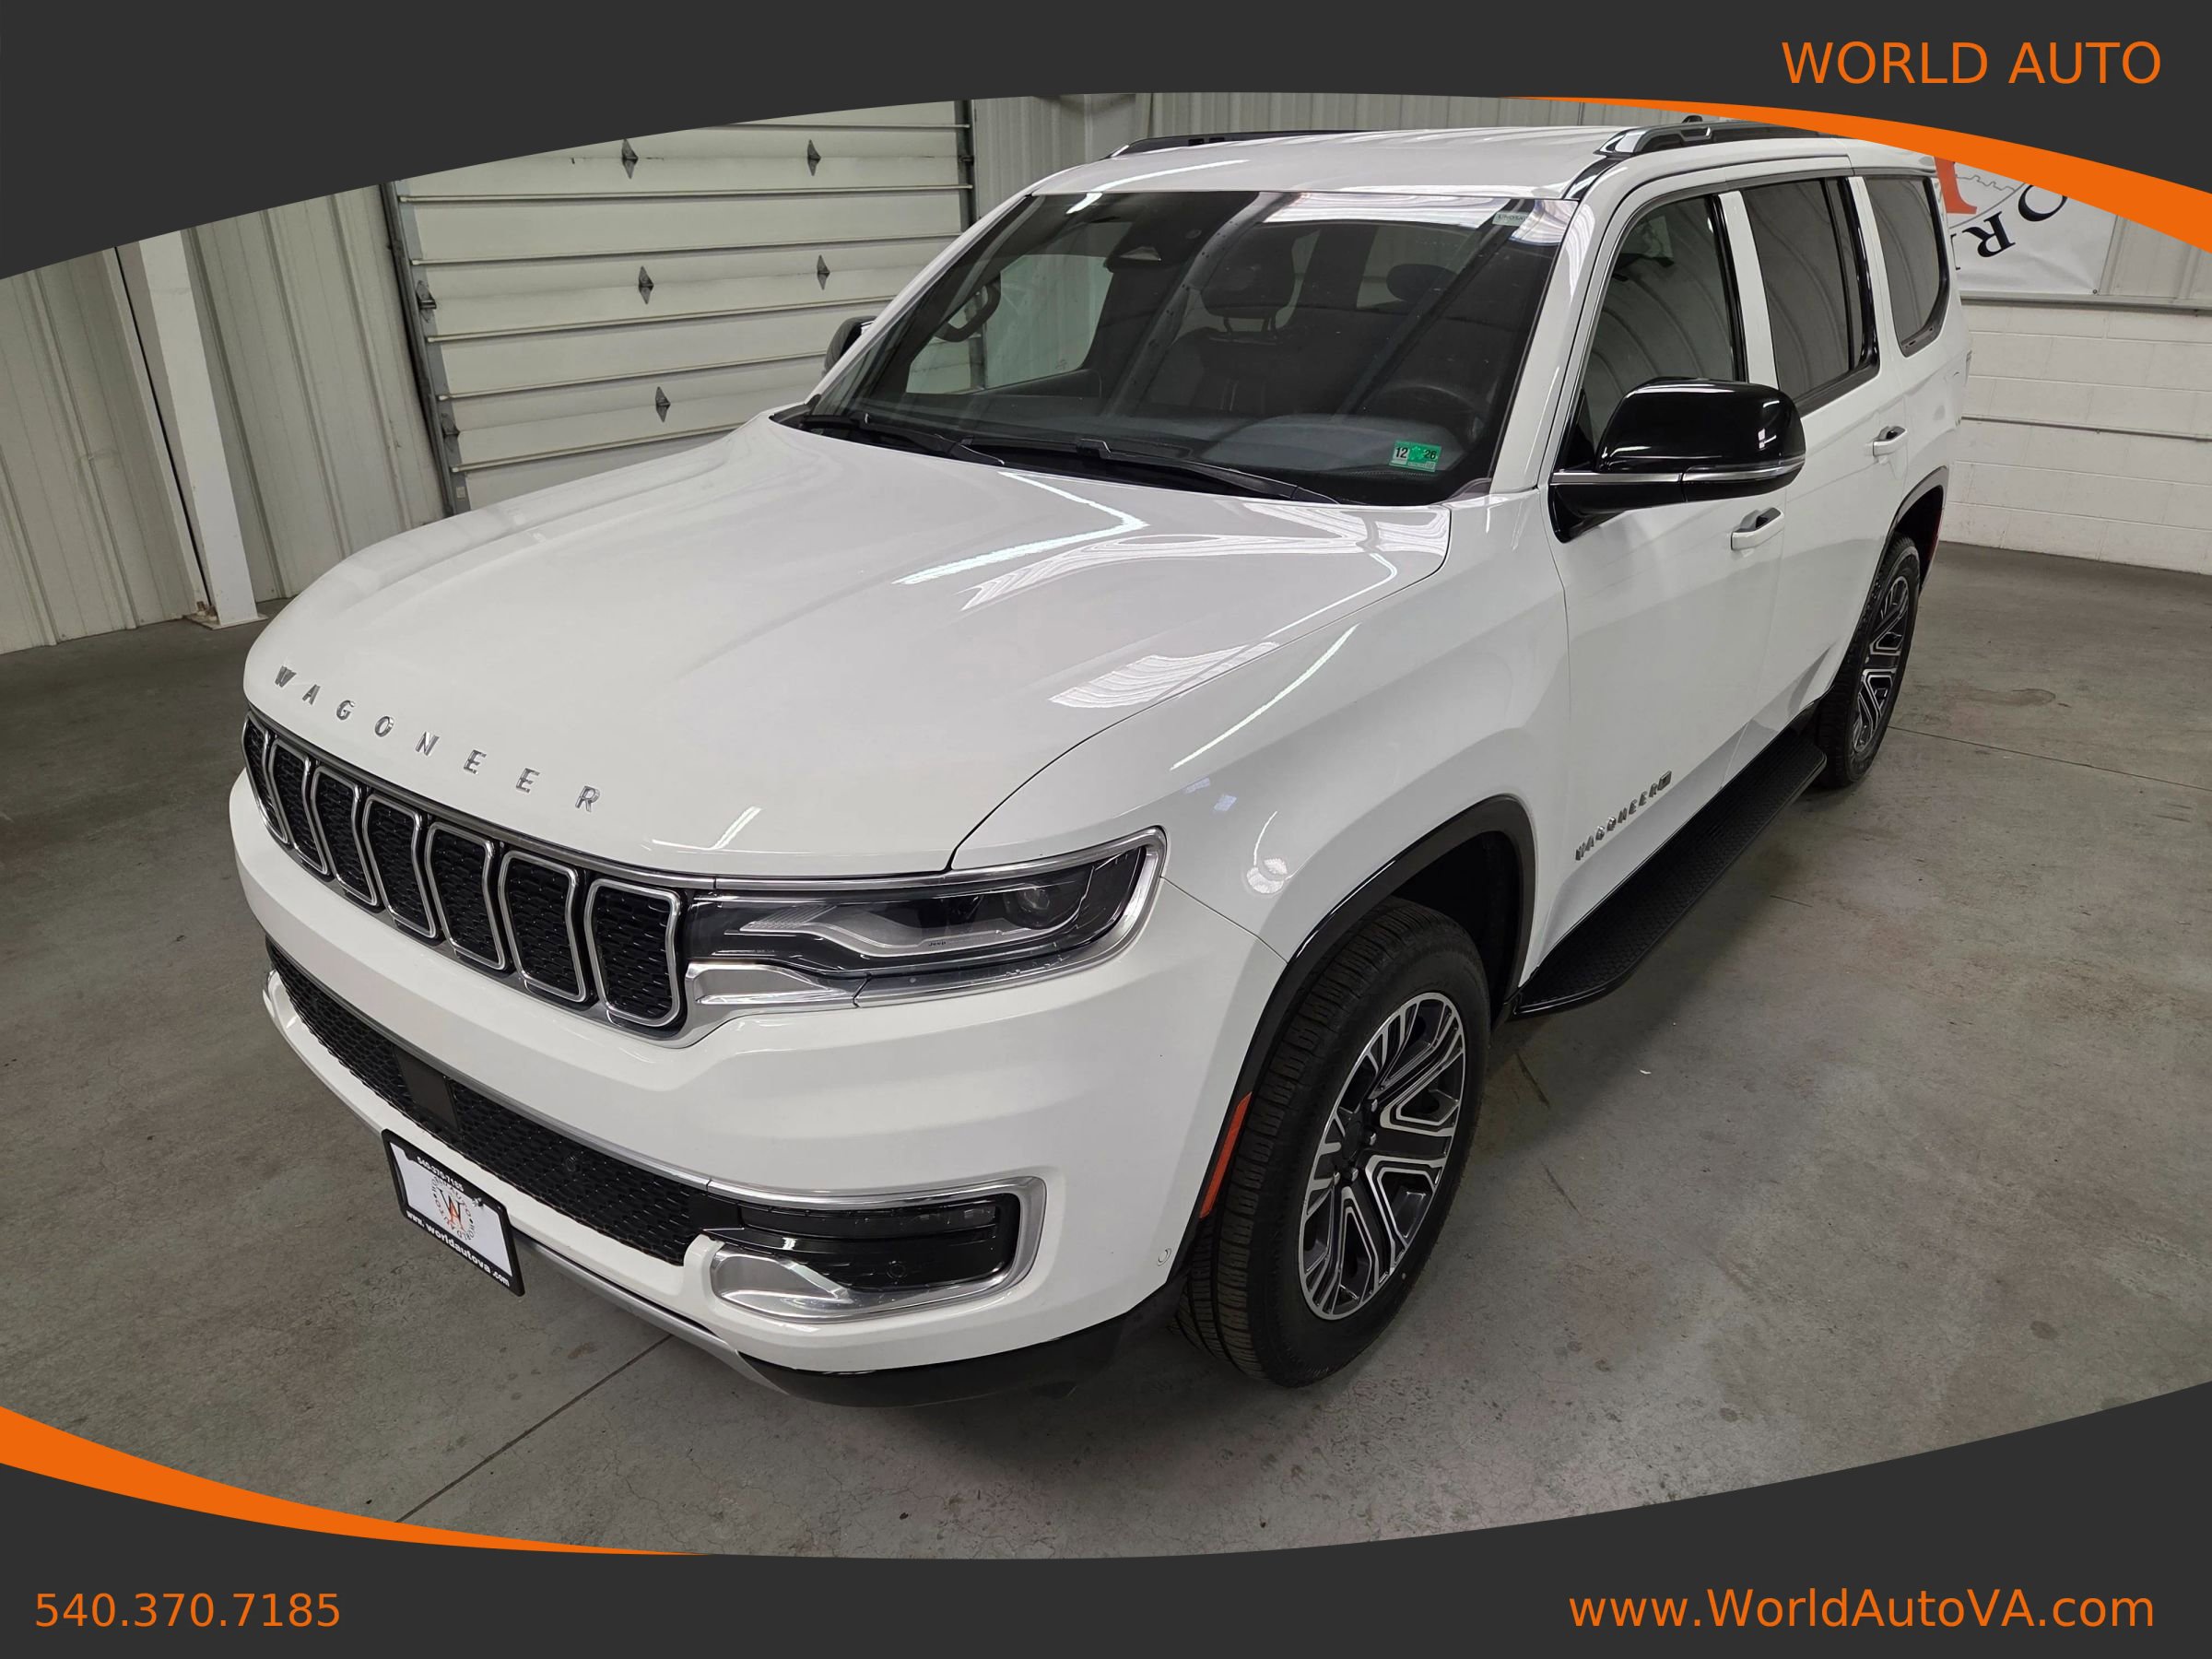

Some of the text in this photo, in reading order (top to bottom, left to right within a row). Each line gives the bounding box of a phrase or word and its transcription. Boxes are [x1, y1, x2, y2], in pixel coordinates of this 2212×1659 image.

[1395, 447, 1437, 460] 12 26
[275, 665, 601, 813] WAGONEER
[1575, 782, 1658, 861] WAGONEER
